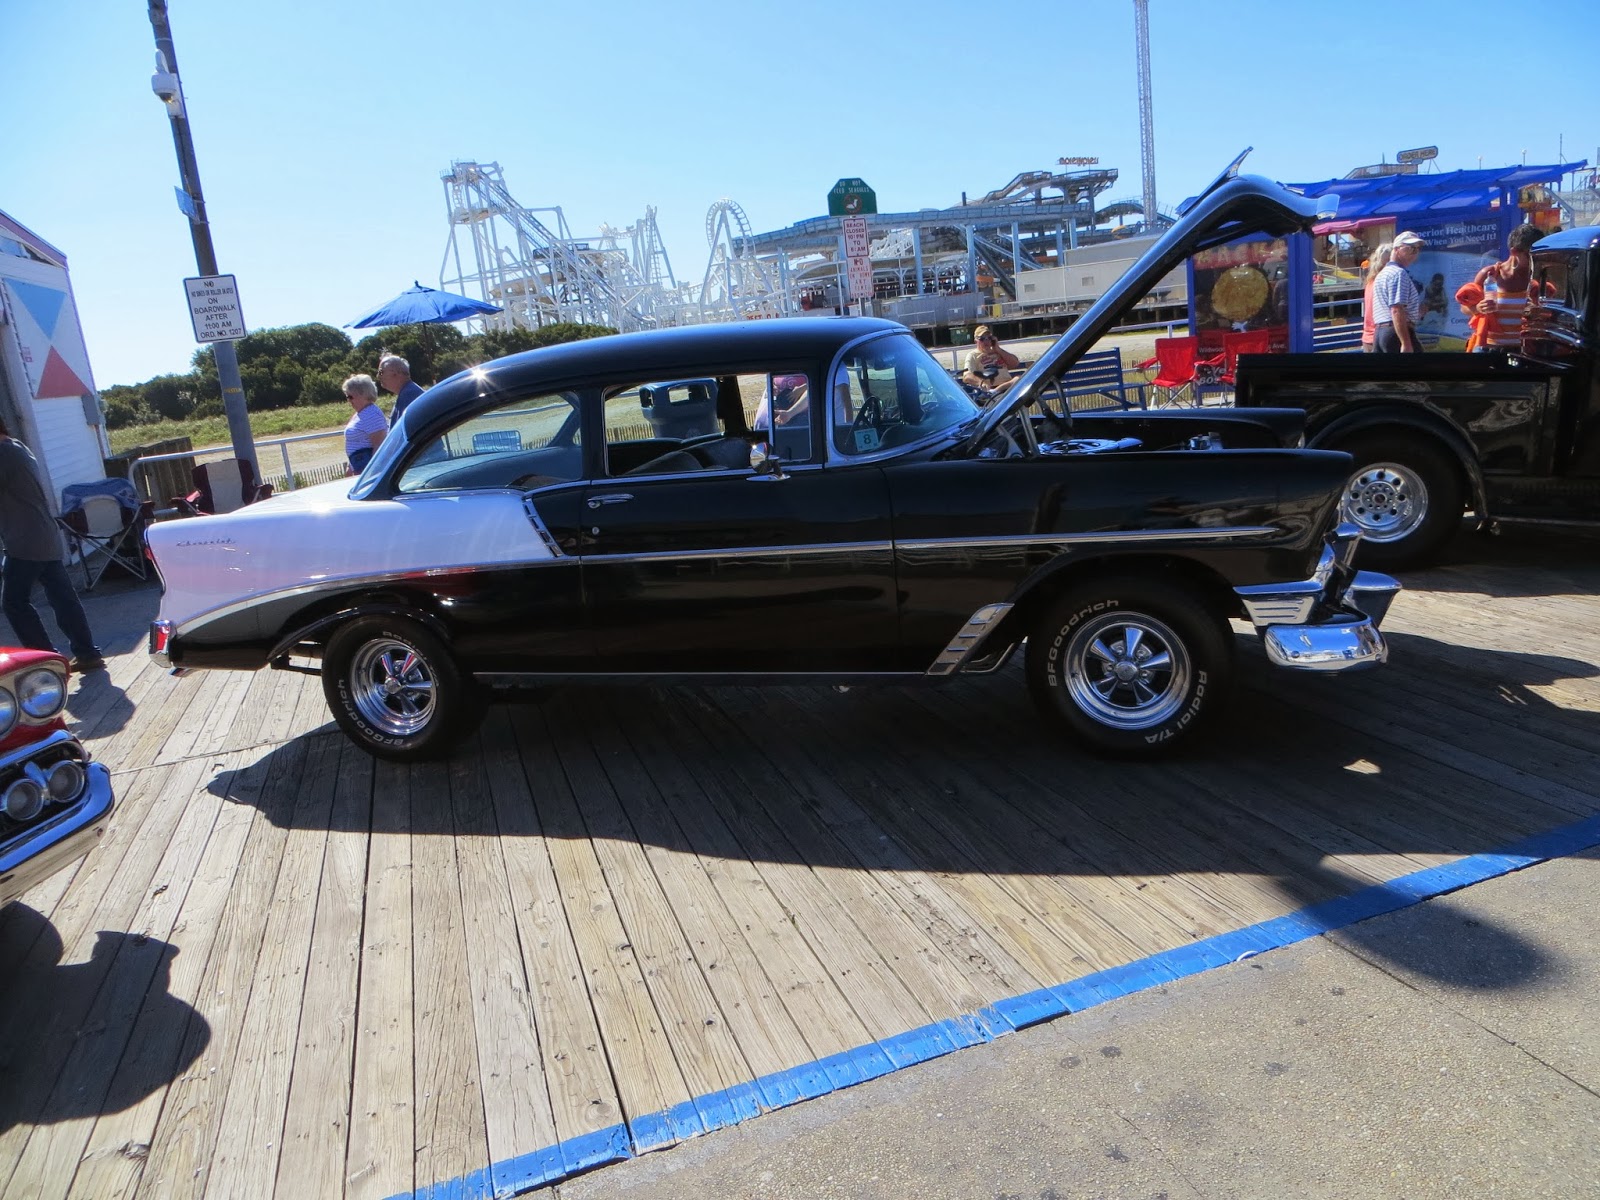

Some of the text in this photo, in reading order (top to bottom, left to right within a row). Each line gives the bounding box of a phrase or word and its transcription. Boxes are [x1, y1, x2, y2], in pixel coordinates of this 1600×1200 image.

[1446, 223, 1497, 236] Healthcare
[1424, 232, 1497, 247] When You Need It!
[854, 258, 864, 266] NO
[194, 304, 236, 314] BOARDWALK
[205, 313, 228, 321] AFTER
[205, 322, 219, 330] 11:00
[229, 328, 241, 336] 1207
[863, 433, 871, 444] 8
[1047, 599, 1119, 687] BFGoodrich
[338, 679, 404, 746] BFGoodrich
[1144, 670, 1208, 744] Radial T/A
